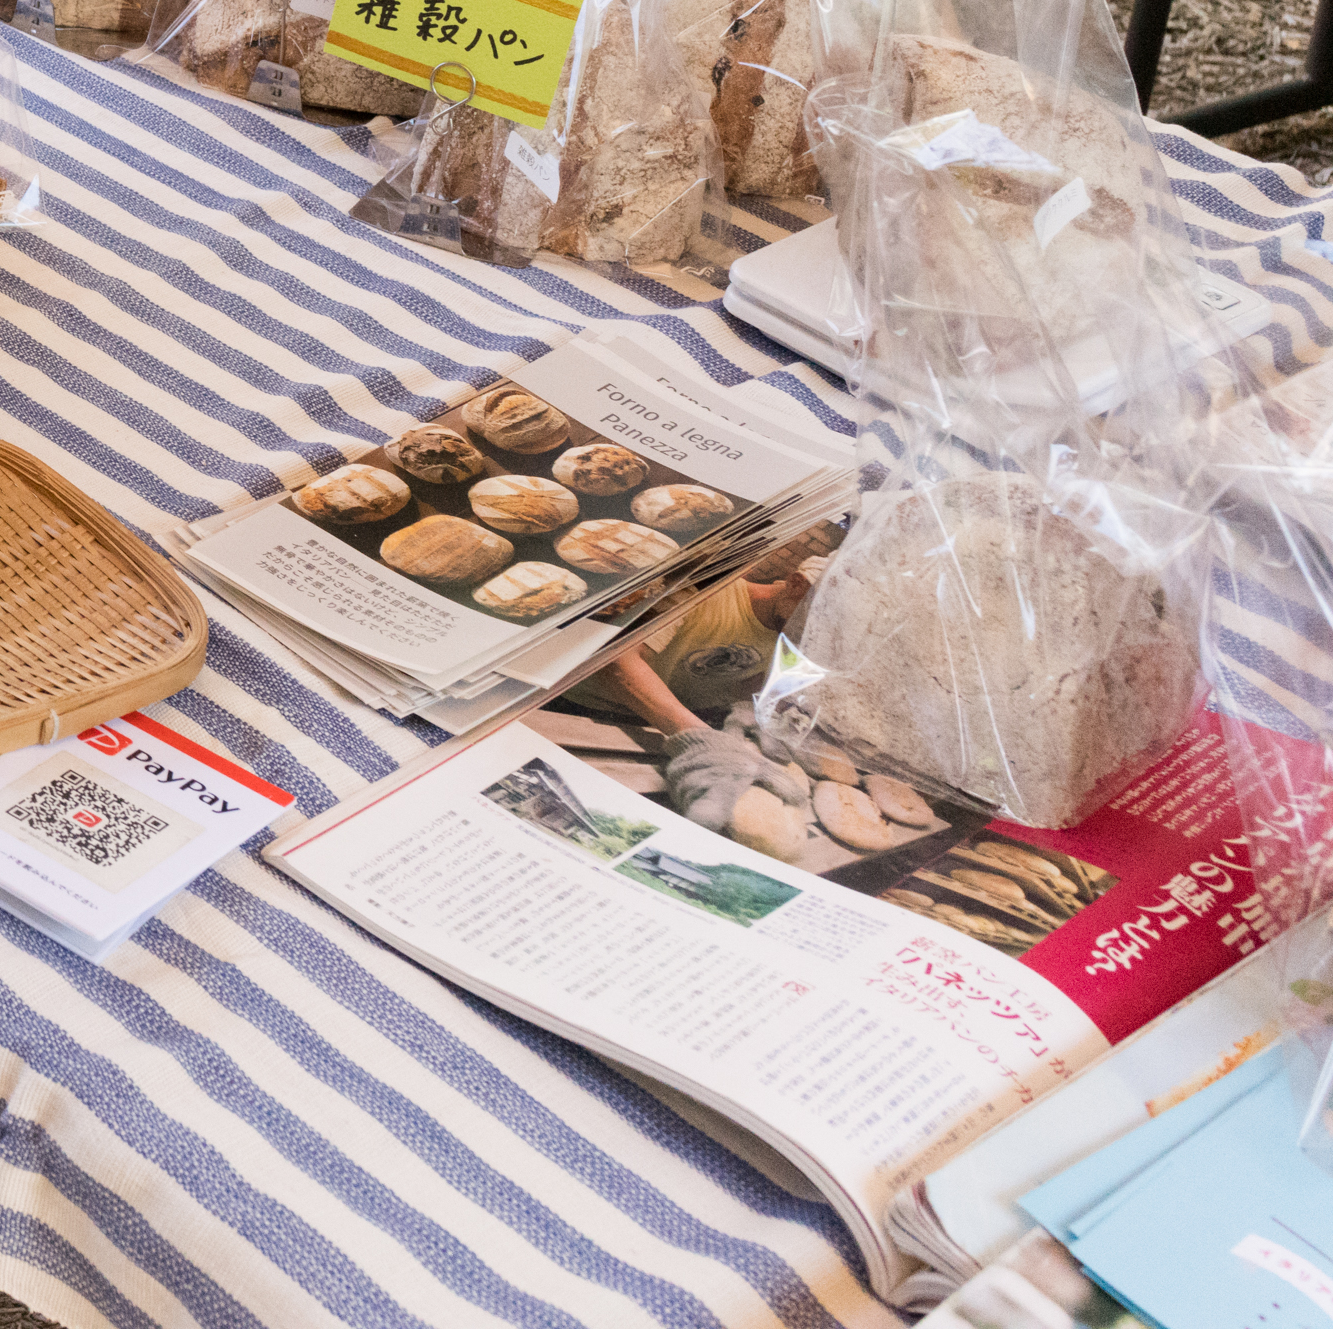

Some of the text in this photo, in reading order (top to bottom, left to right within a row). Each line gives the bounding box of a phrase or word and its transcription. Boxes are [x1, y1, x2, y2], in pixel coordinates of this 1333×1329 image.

[596, 382, 660, 422] Forno
[660, 419, 679, 432] a
[679, 426, 745, 461] legna
[599, 412, 689, 462] Panezza
[125, 748, 242, 816] PayPay
